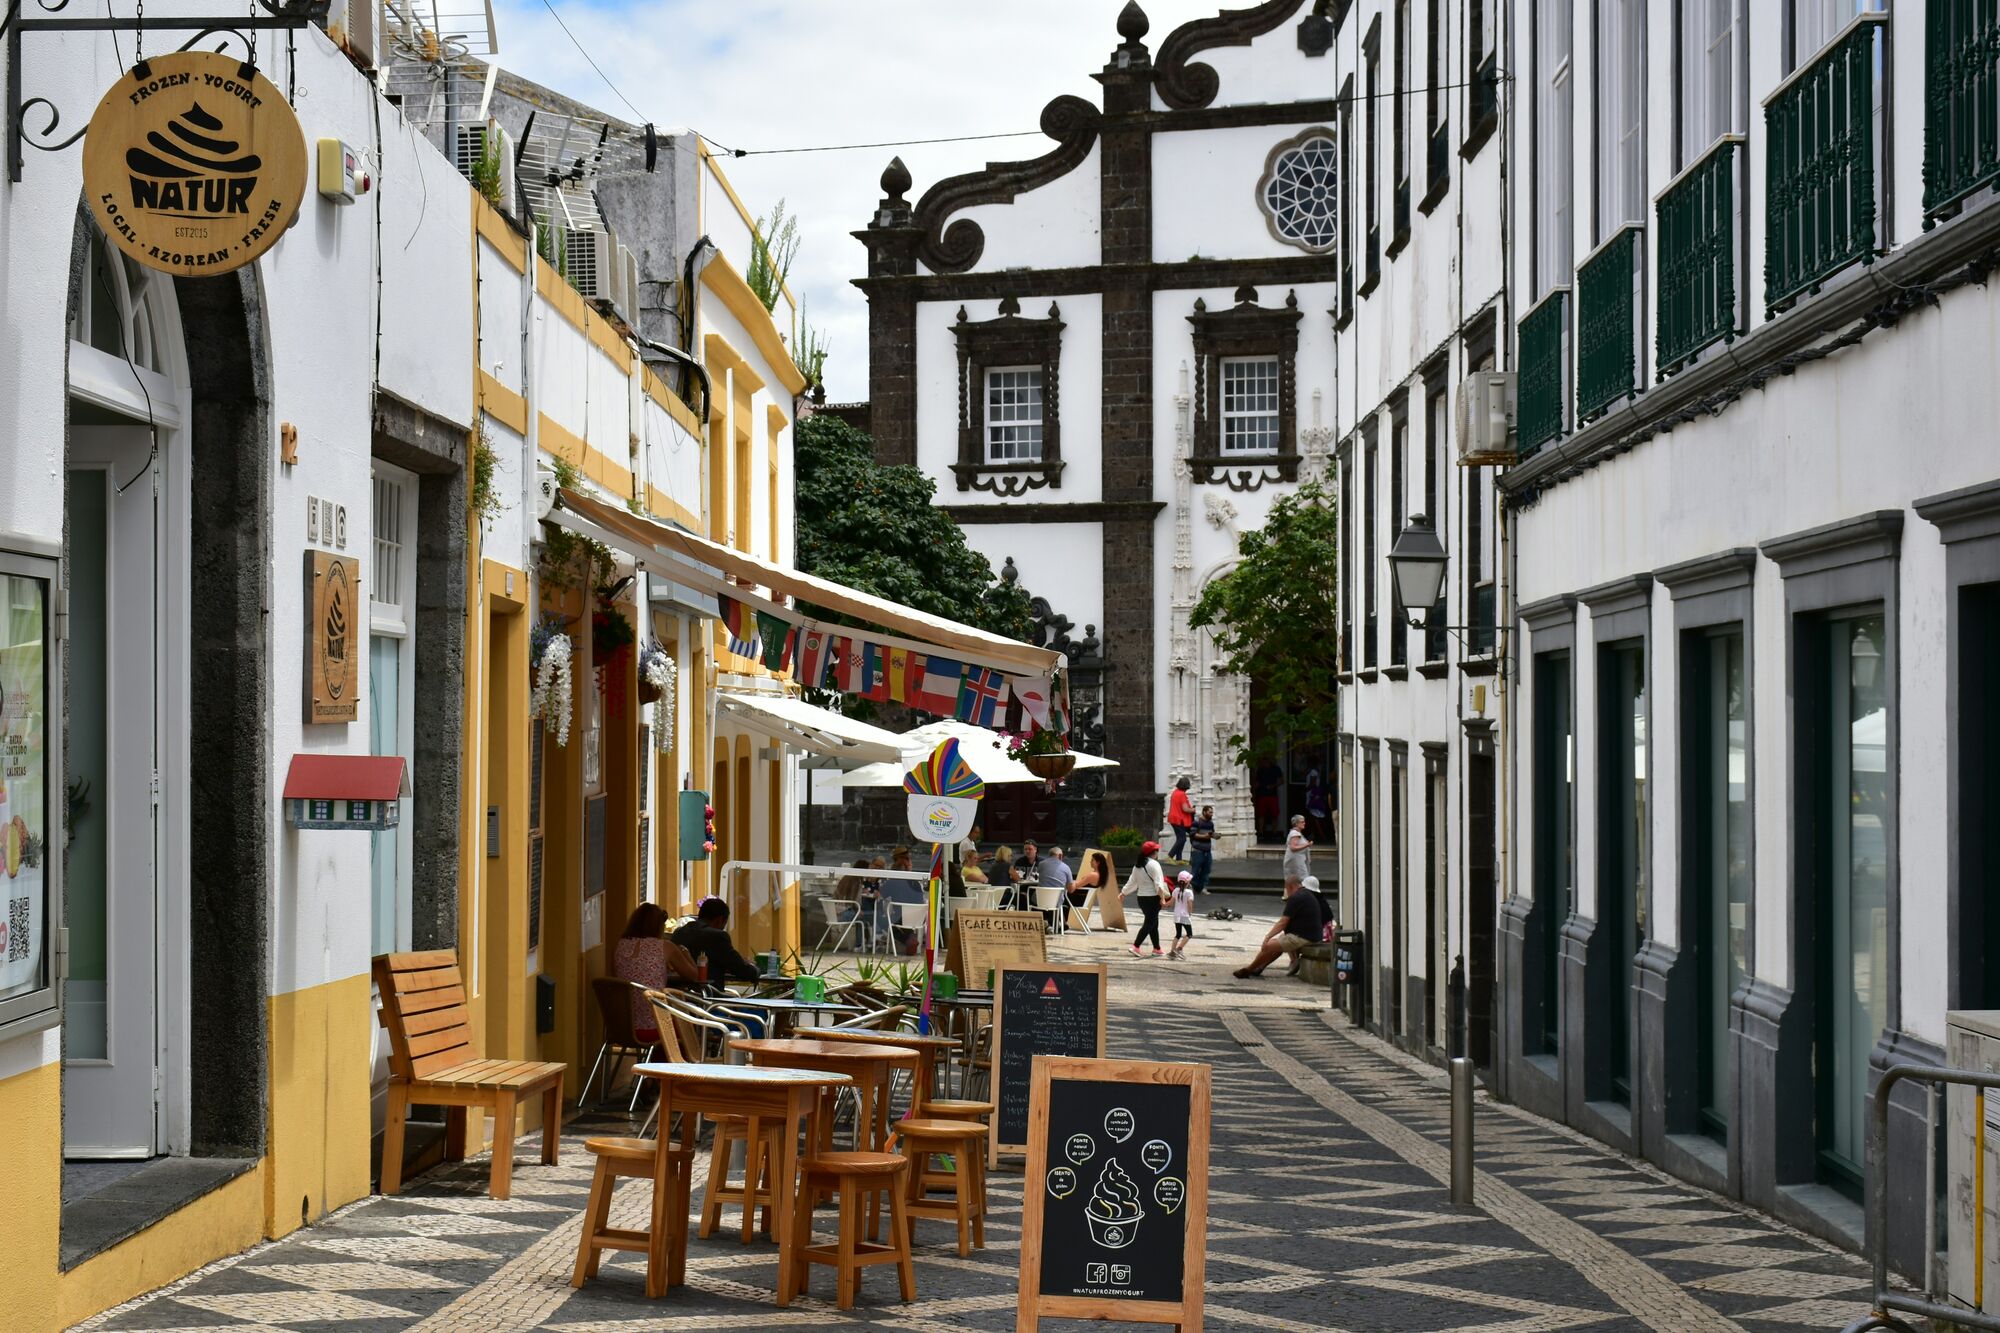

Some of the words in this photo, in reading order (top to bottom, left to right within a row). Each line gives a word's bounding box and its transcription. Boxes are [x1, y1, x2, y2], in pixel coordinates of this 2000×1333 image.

[129, 72, 190, 106] FROZEN
[204, 73, 262, 109] YOGURT
[129, 174, 258, 214] NATUR
[101, 193, 136, 243] LOCAL
[148, 246, 230, 266] AZOREAN
[241, 199, 281, 247] FRESH
[929, 818, 952, 828] NATUR
[993, 920, 1040, 932] CENTRAL
